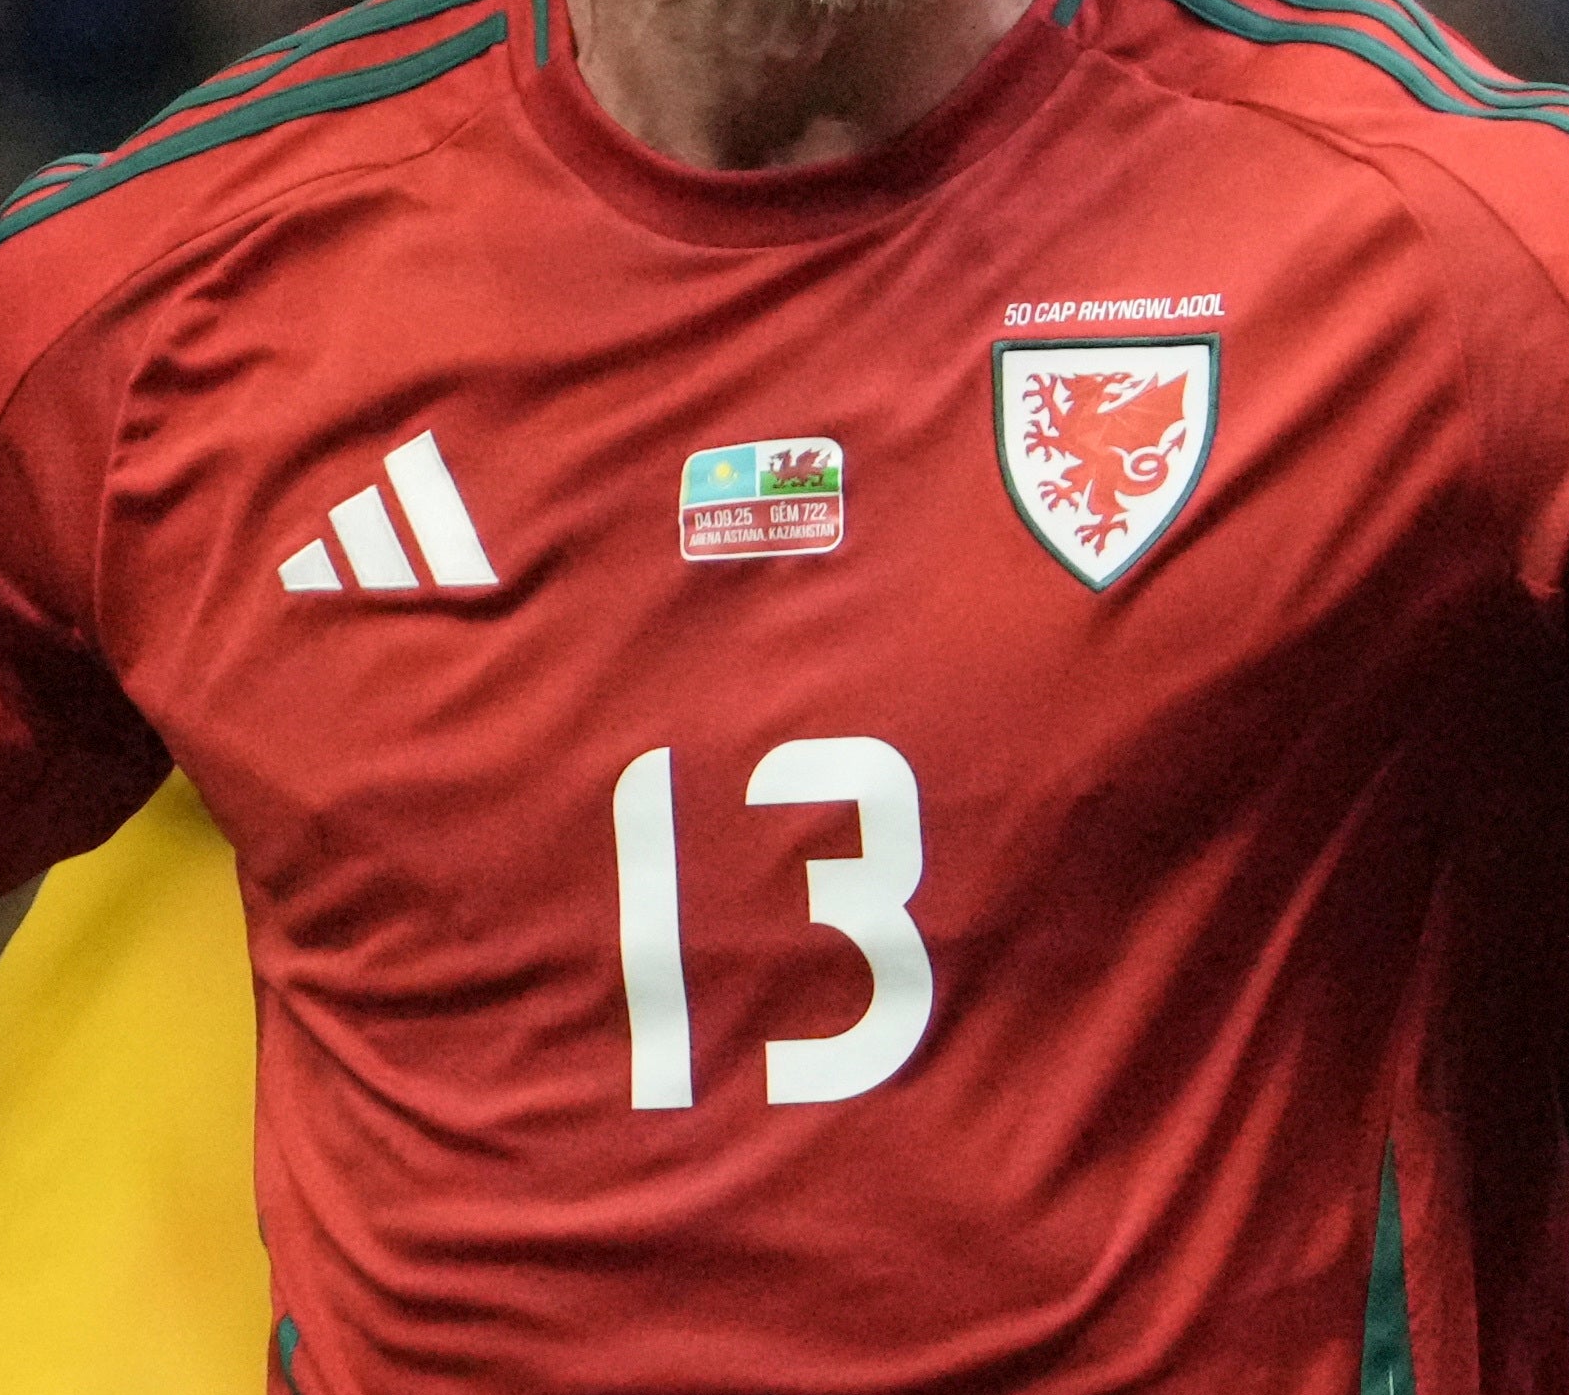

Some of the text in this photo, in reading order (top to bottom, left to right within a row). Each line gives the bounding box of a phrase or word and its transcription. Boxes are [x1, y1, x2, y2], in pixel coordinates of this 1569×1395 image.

[1003, 293, 1226, 326] 50 CAP RHYNGWLADOL
[694, 507, 753, 530] 04.09.25
[803, 502, 829, 521] 722
[615, 737, 932, 1110] 13
